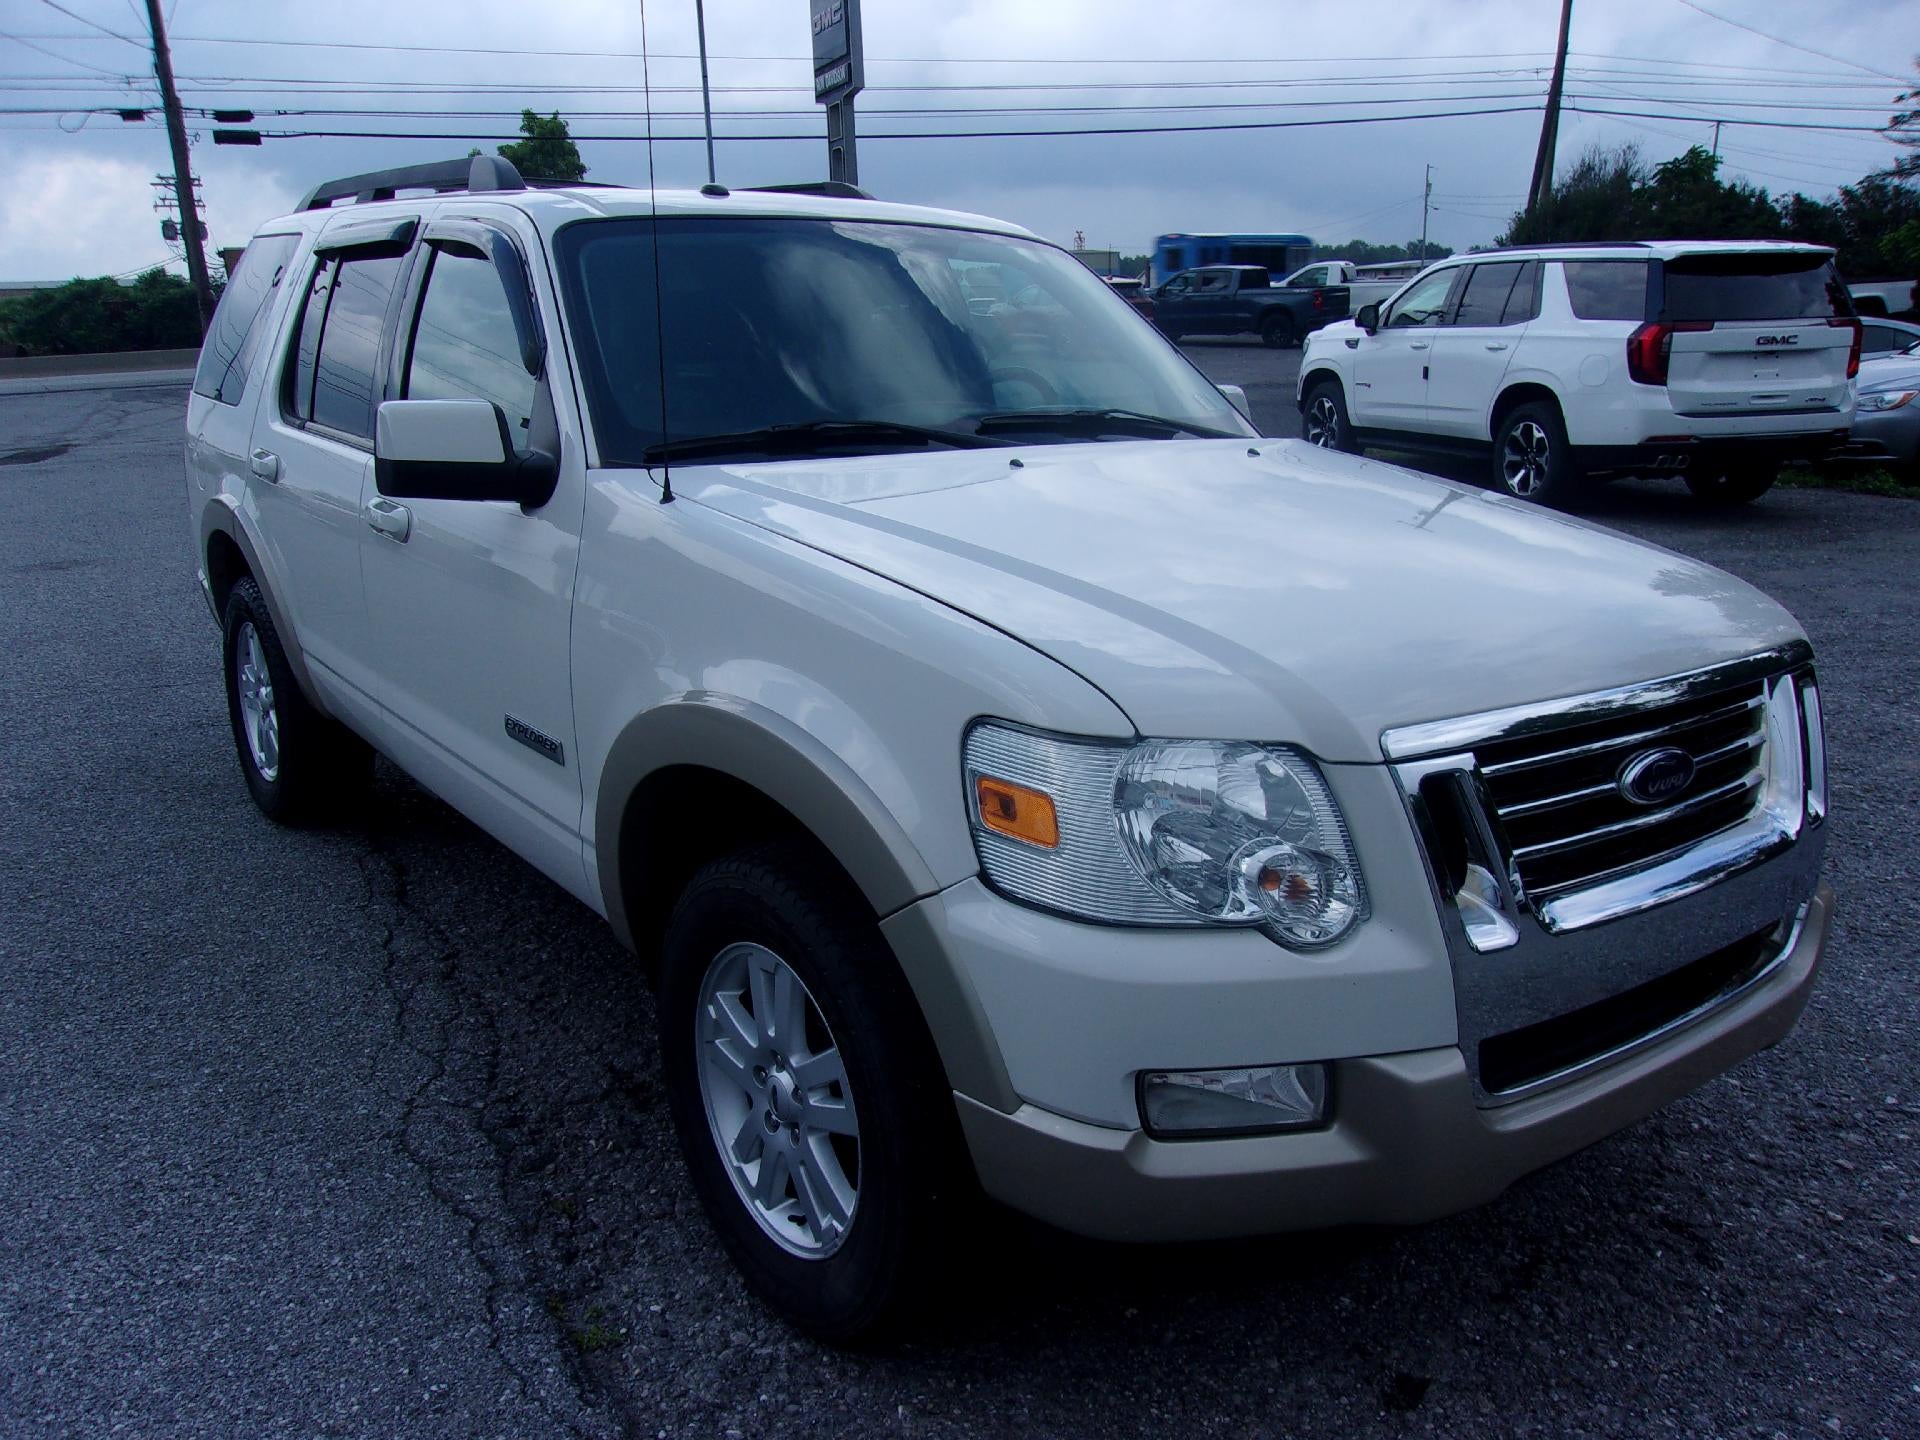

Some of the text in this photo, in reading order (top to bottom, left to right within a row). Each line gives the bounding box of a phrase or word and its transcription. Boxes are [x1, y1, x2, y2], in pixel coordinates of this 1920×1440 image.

[812, 1, 843, 36] GMC
[1756, 334, 1799, 346] GMC
[505, 717, 559, 753] EXPLORER
